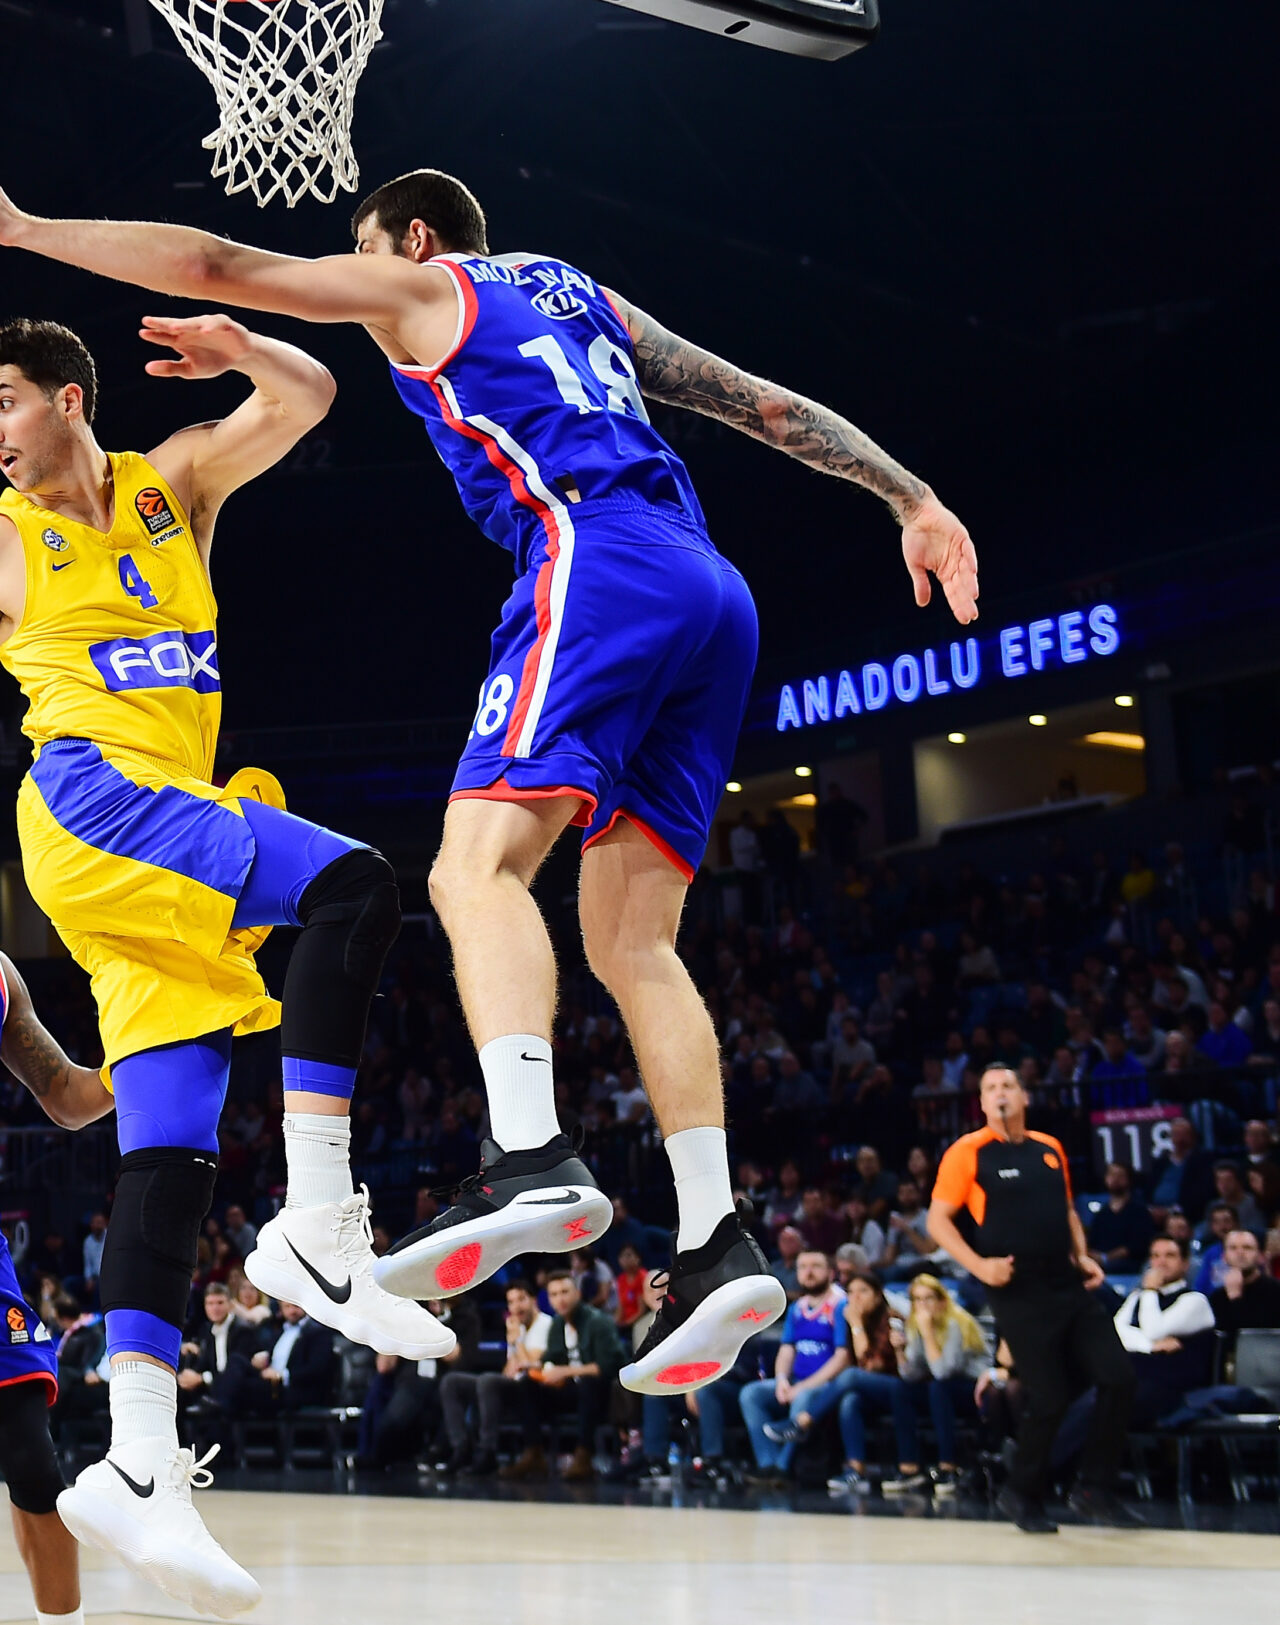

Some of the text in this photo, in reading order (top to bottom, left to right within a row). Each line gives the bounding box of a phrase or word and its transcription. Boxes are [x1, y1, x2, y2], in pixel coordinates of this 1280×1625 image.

[517, 333, 651, 428] 18
[117, 553, 159, 610] 4
[109, 641, 220, 682] FOX
[776, 604, 1120, 732] ANADOLU EFES
